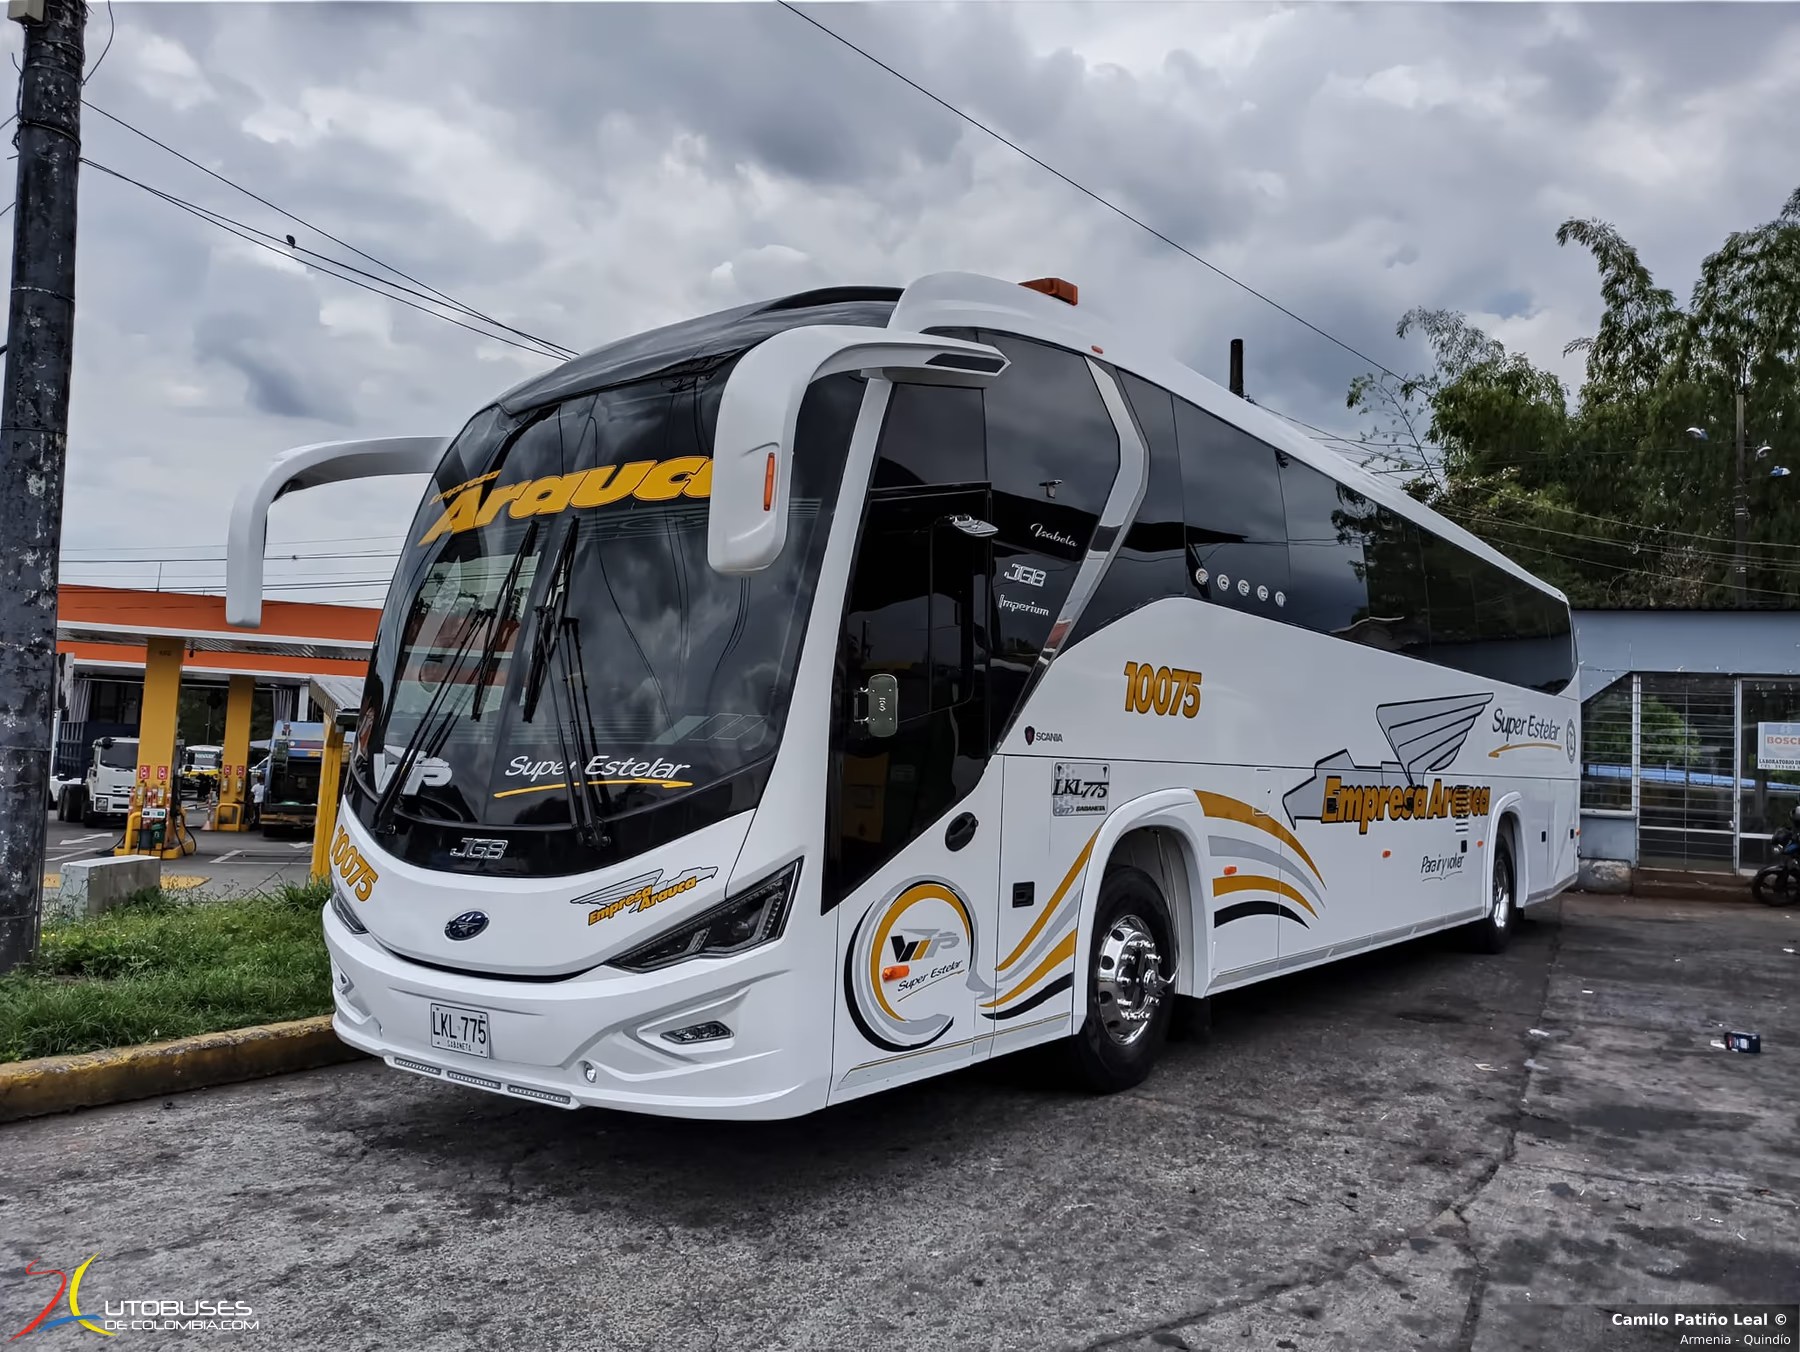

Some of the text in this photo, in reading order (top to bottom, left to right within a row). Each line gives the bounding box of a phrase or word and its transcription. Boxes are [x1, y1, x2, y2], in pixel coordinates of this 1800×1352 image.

[1030, 522, 1079, 547] Isabela
[1003, 562, 1047, 588] JGB
[998, 593, 1050, 616] Imperium
[1123, 660, 1203, 719] 10075
[1035, 731, 1064, 743] SCANIA
[1492, 707, 1527, 743] Super
[1527, 714, 1561, 741] Estelar
[584, 755, 693, 779] Estelar
[332, 824, 379, 902] 10075
[449, 837, 508, 860] JGB
[588, 876, 698, 926] Empresa Arauca
[897, 960, 963, 992] Super Estelar
[432, 1010, 487, 1045] LKL 775
